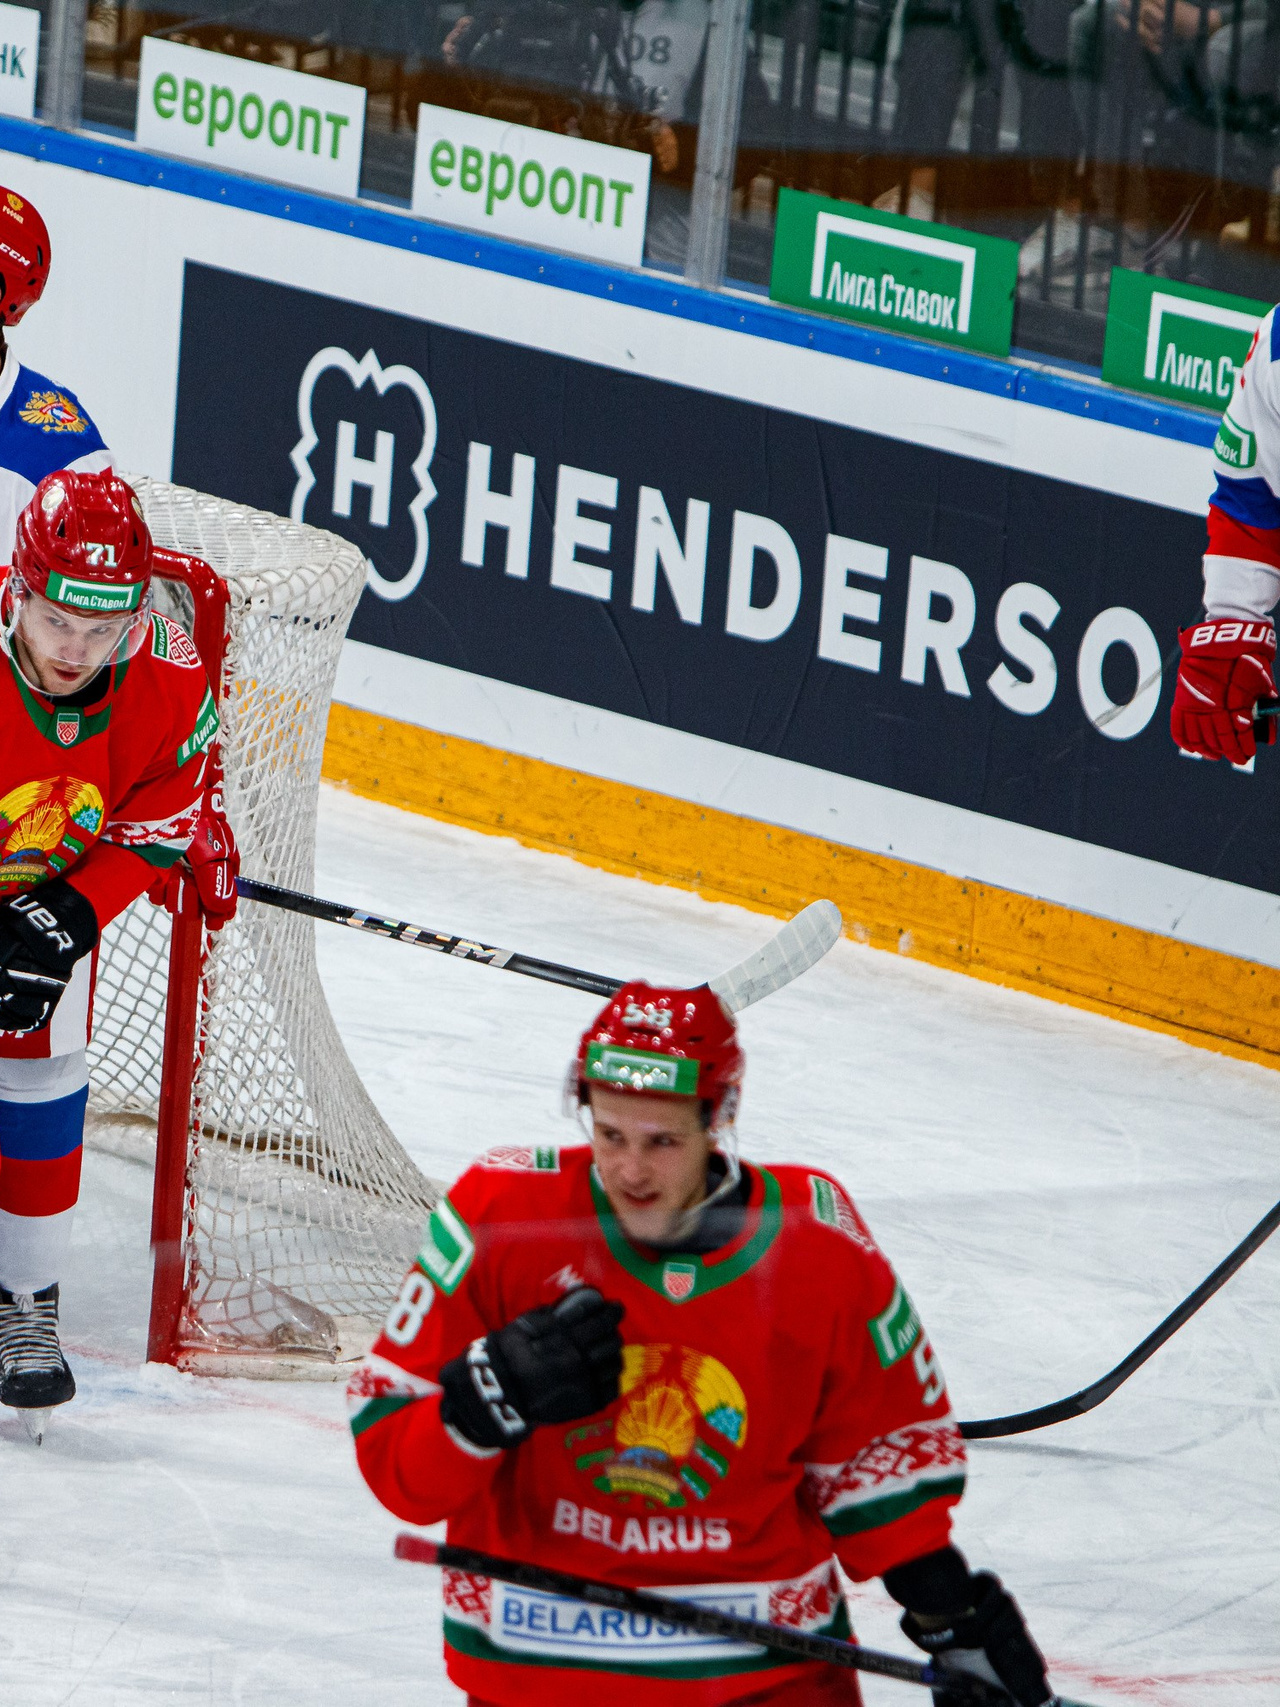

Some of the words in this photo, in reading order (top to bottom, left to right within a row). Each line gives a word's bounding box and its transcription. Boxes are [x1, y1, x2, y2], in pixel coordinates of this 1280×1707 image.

[153, 71, 350, 160] евроопт
[429, 138, 635, 228] евроопт
[86, 542, 118, 568] 71
[460, 440, 1256, 774] HENDERSO
[1189, 622, 1277, 648] BAUE
[552, 1497, 732, 1553] BELARUS
[502, 1595, 758, 1639] BELARUS
